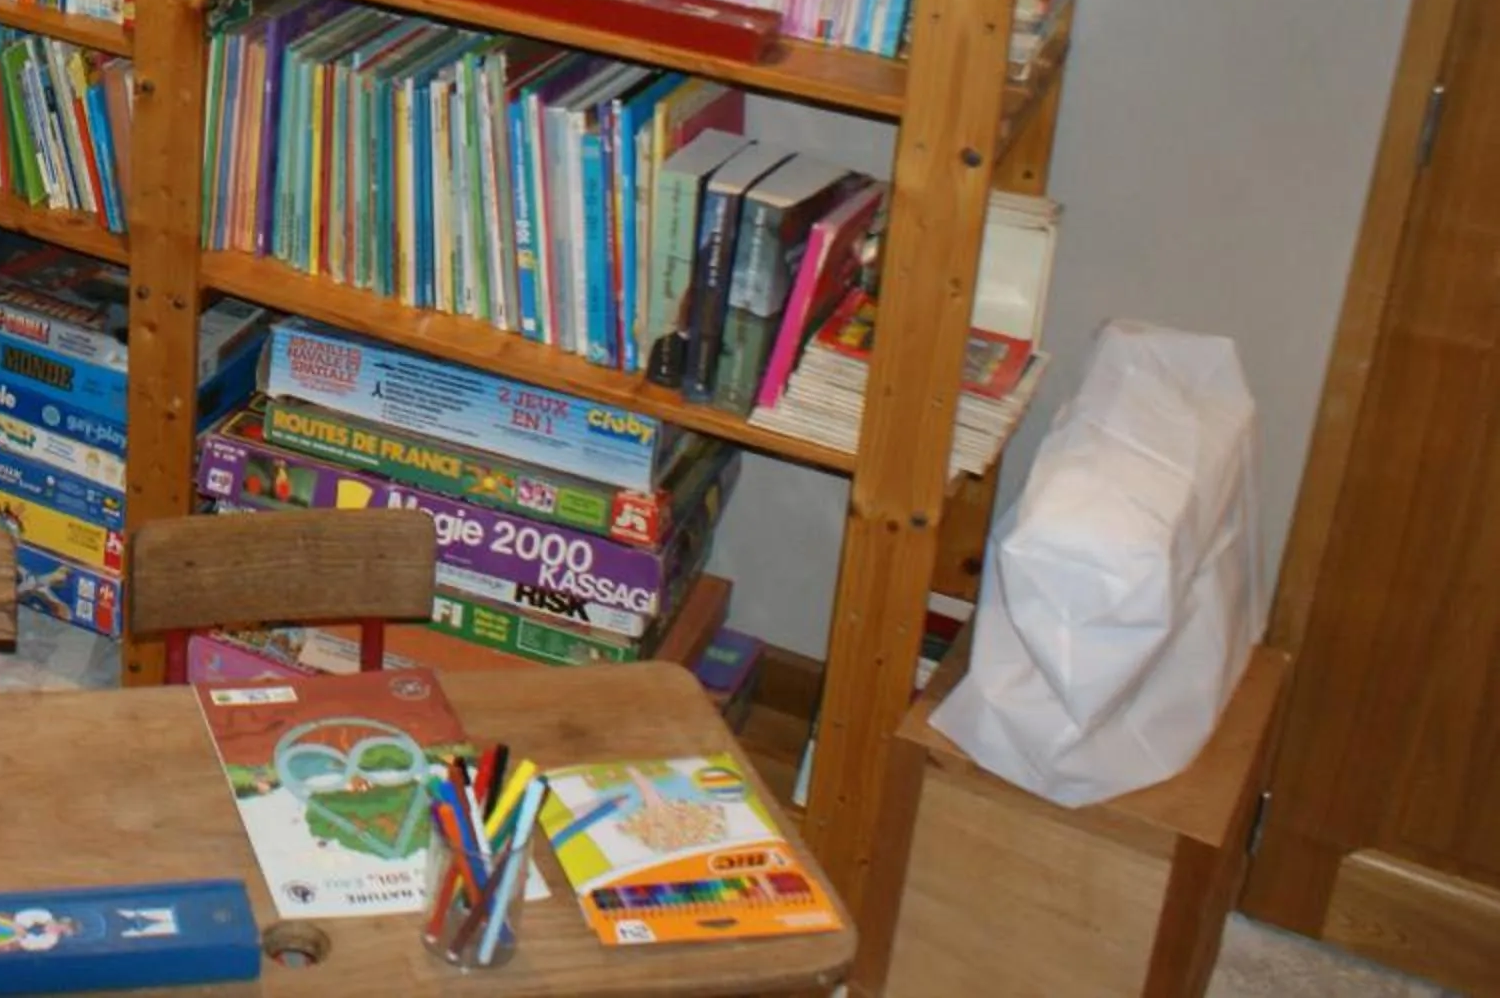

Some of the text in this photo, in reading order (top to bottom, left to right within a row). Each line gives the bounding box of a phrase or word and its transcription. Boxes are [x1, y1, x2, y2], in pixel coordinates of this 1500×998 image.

[2, 344, 74, 393] MONDE
[500, 386, 511, 403] 2
[514, 390, 569, 420] JEUX
[512, 408, 541, 432] EN
[273, 408, 348, 446] ROUTES
[351, 428, 379, 455] DE
[381, 438, 462, 480] FRANCE
[388, 487, 594, 574] Mgie 2000
[514, 582, 590, 622] RISK
